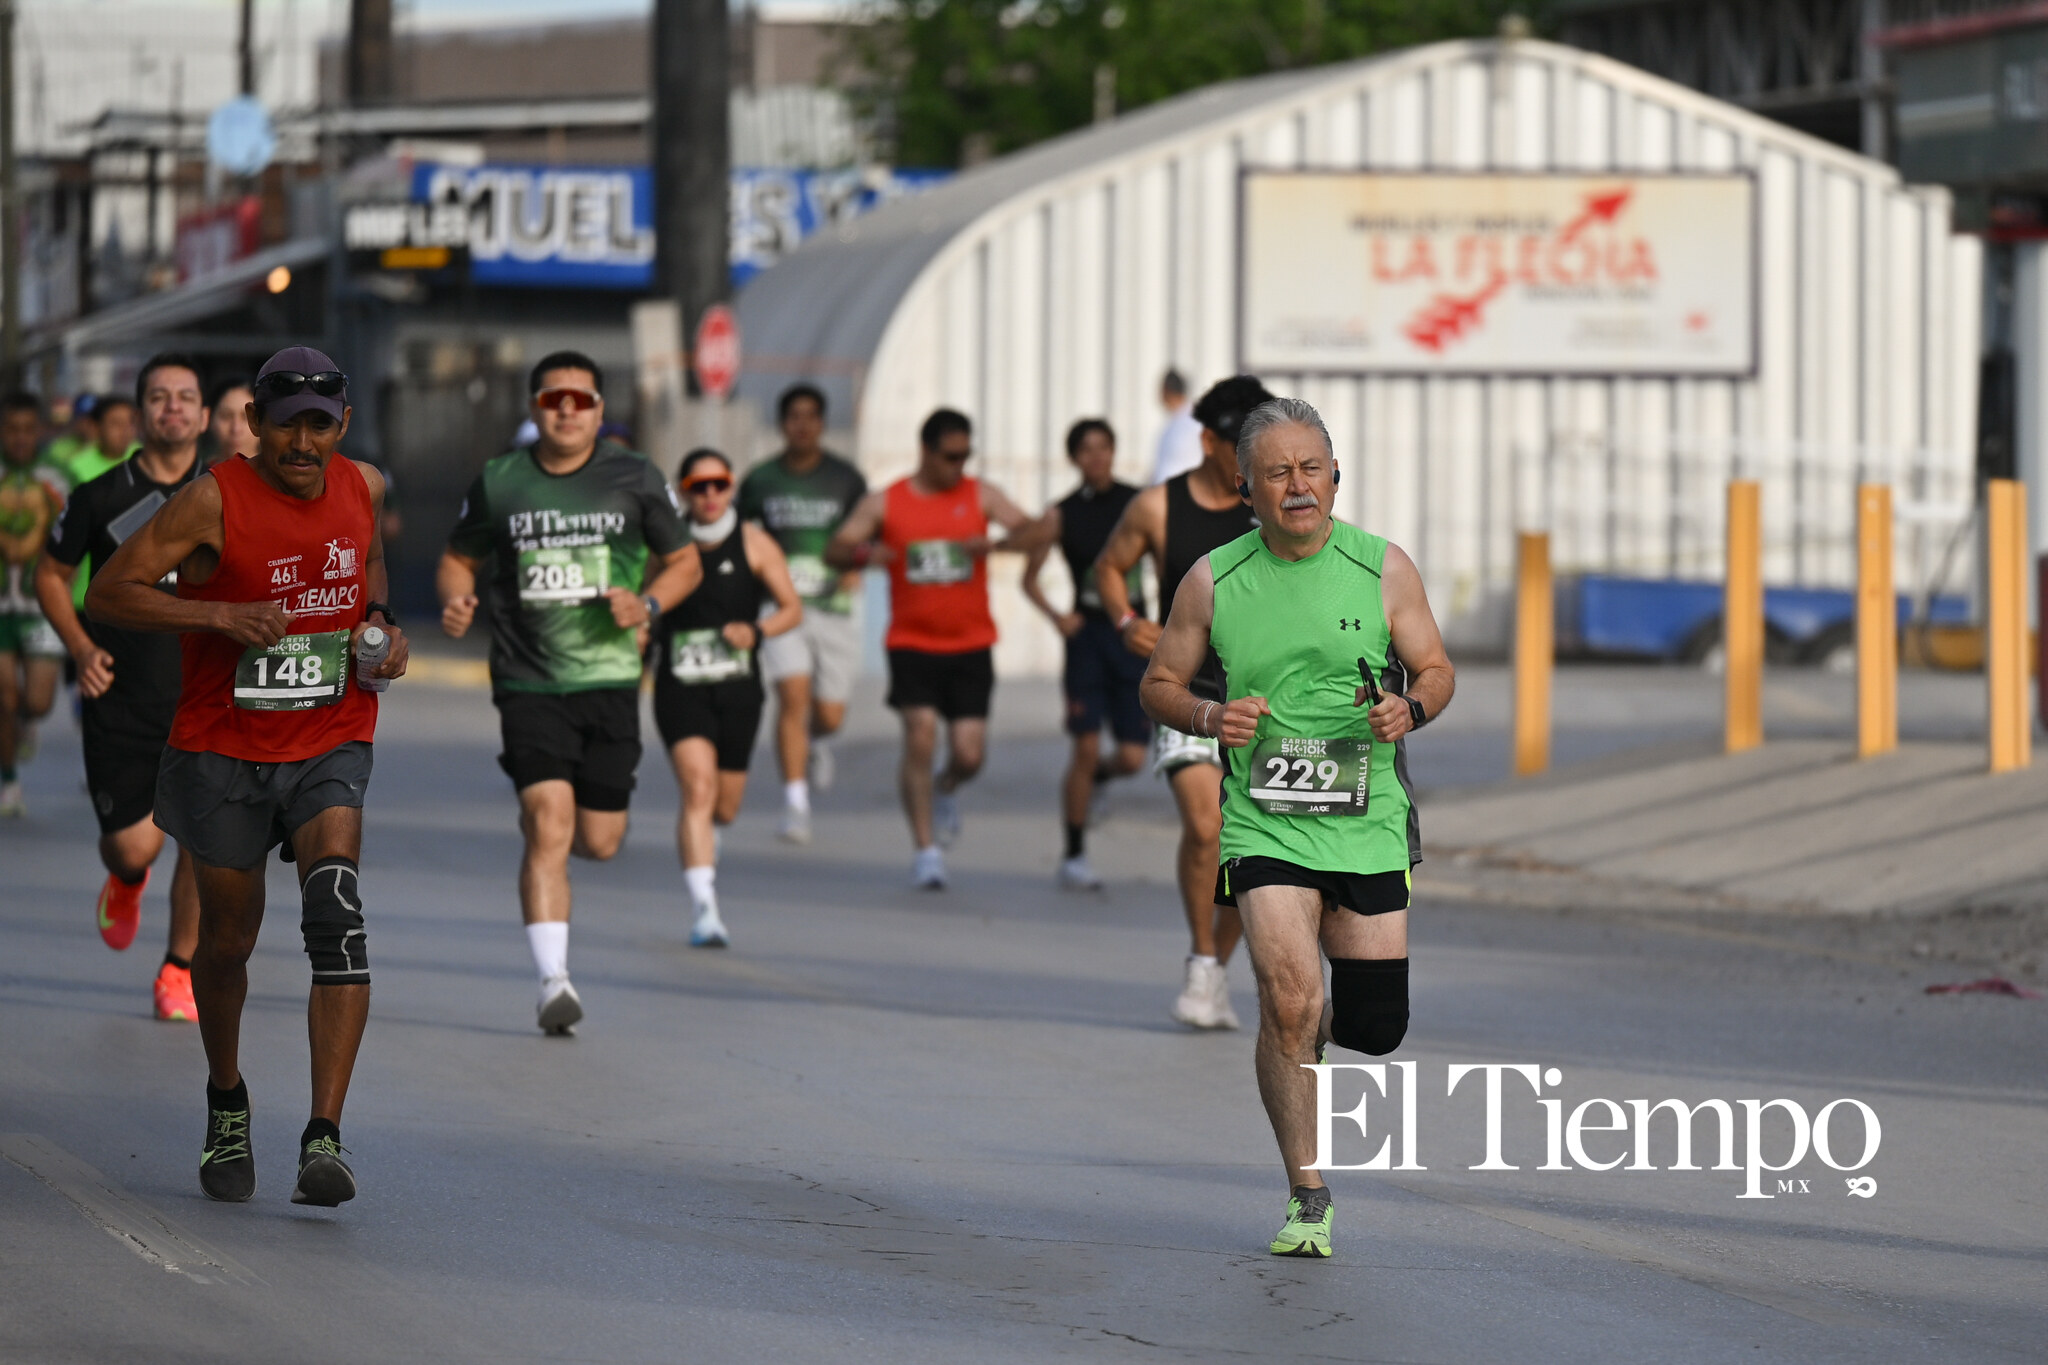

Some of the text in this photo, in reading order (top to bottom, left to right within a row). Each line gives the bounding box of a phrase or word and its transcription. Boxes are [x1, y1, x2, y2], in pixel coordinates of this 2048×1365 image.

[508, 509, 625, 537] El Tiempo
[540, 533, 606, 549] todos
[268, 555, 302, 567] CELEBRANDO
[324, 567, 357, 580] RETO TIEMPO
[271, 566, 291, 585] 46
[527, 563, 585, 590] 208
[254, 655, 323, 687] 148
[337, 647, 347, 696] MEDALLA
[1281, 737, 1327, 746] CARRERA
[1265, 757, 1339, 790] 229
[1356, 756, 1368, 807] MEDALLA
